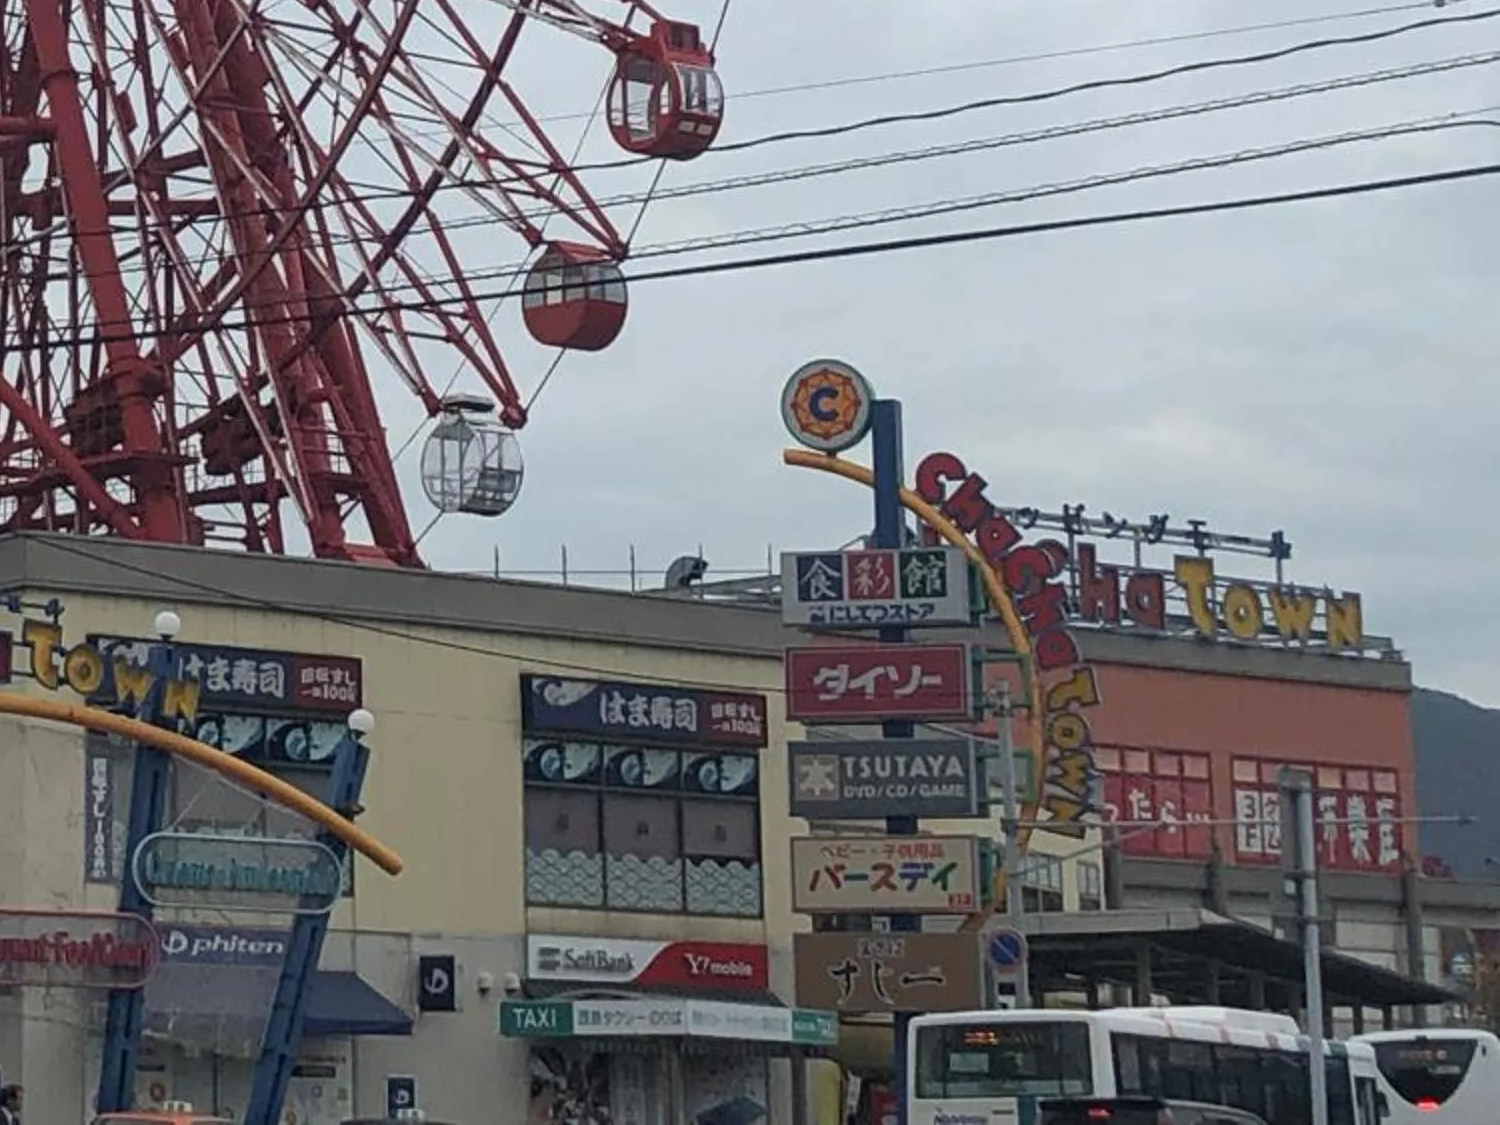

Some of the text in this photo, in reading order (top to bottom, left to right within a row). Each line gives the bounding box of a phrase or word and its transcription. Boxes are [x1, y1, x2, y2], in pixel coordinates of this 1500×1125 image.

[802, 554, 947, 600] 食彩館
[829, 603, 936, 622] にしてつストア
[813, 663, 943, 701] ダイソー
[600, 690, 698, 732] はま寿司
[842, 755, 966, 778] TSUTAYA
[808, 862, 959, 893] バースデイ
[192, 934, 284, 956] phiten
[563, 948, 636, 973] SoftBank
[513, 1007, 558, 1028] TAXI
